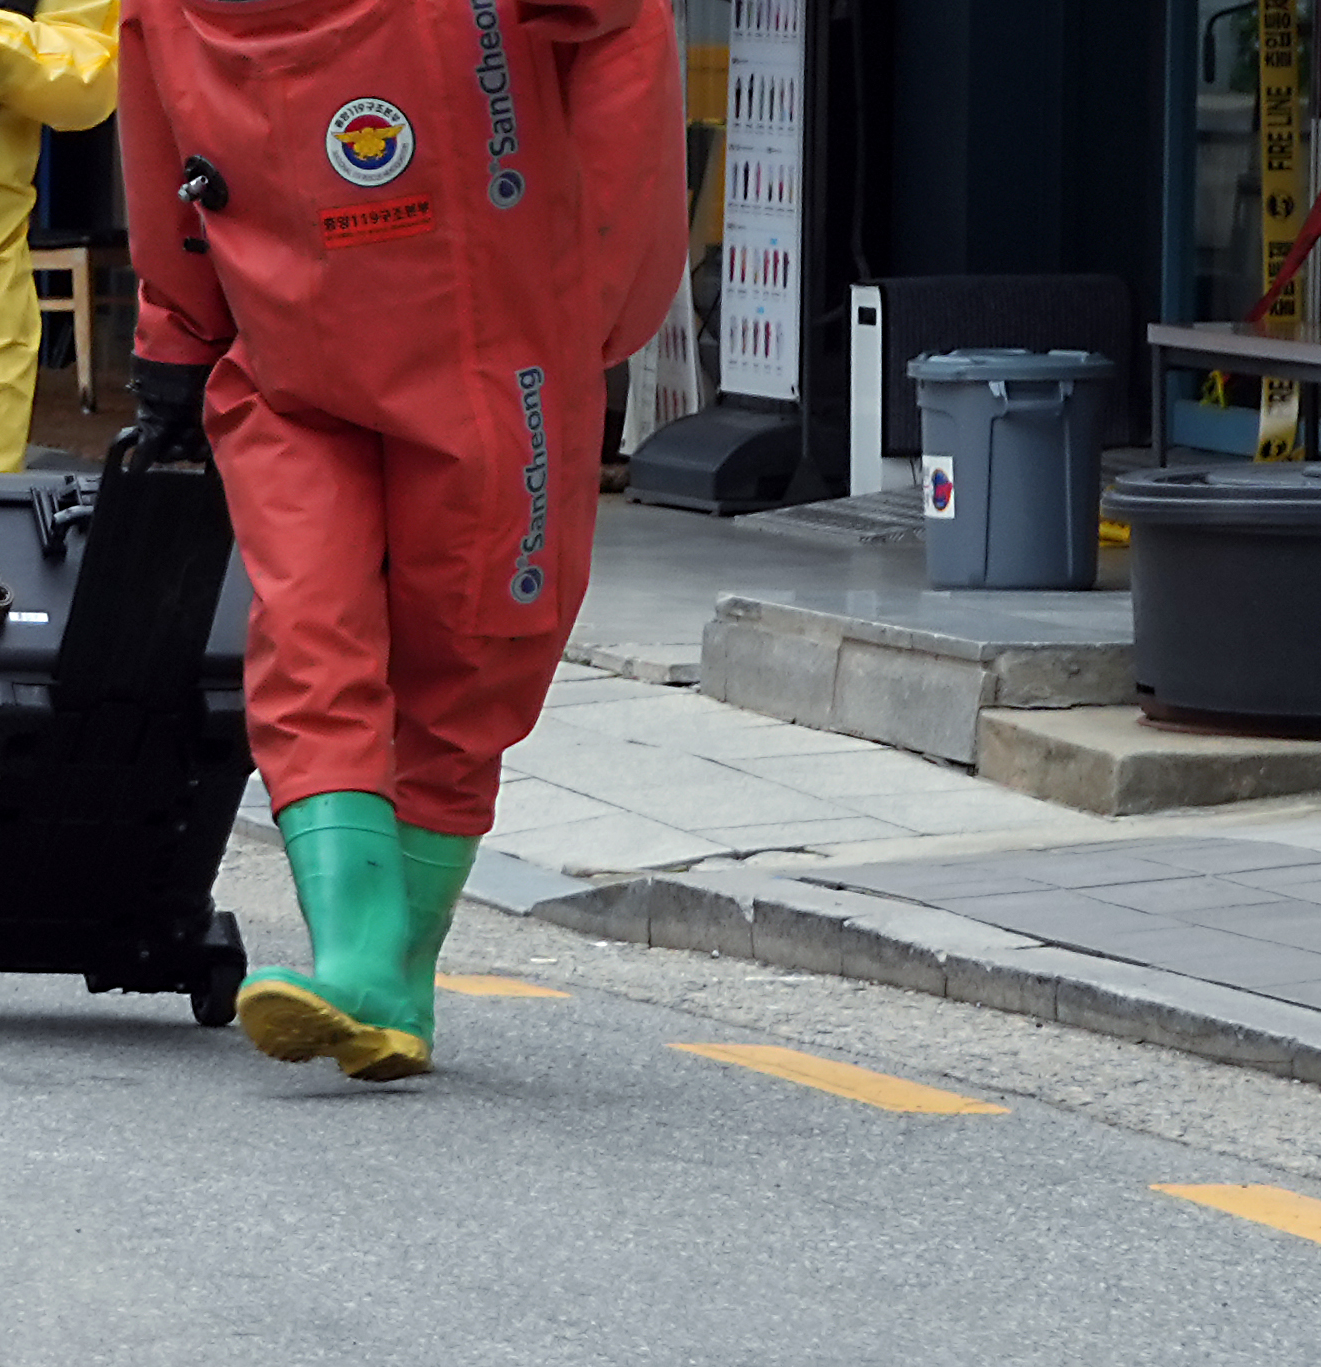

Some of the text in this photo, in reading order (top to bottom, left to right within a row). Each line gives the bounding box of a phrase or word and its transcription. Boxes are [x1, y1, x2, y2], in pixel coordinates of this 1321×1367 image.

[1265, 86, 1295, 172] FIRE LINE
[519, 368, 546, 553] SanCheong
